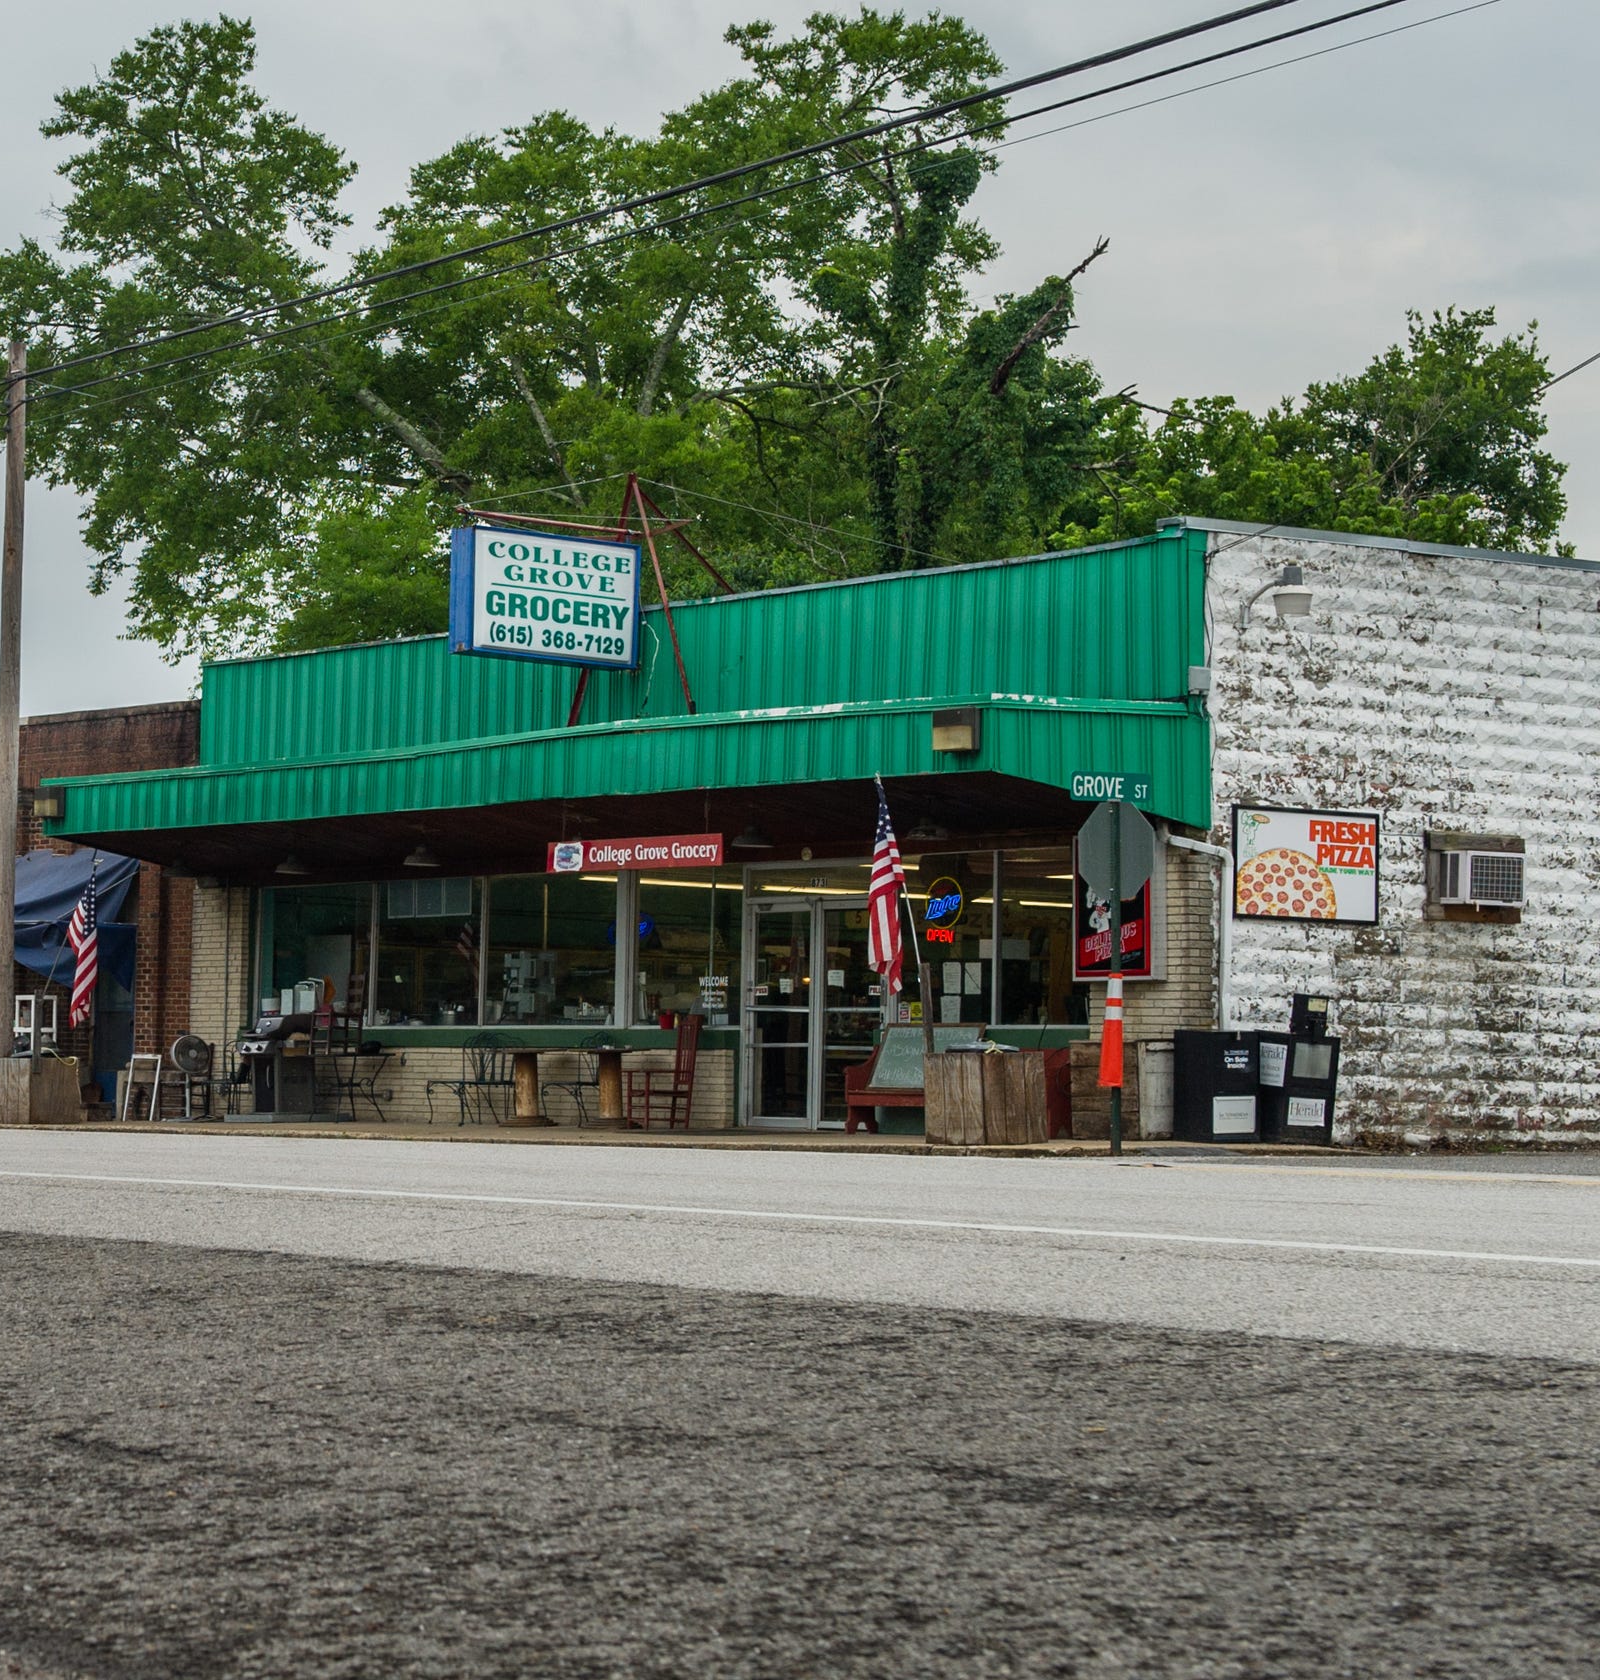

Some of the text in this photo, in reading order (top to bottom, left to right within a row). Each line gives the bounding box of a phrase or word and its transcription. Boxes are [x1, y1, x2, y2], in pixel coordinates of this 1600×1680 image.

[488, 541, 631, 574] COLLEGE
[503, 564, 615, 593] GROVE
[485, 590, 630, 630] GROCERY
[490, 621, 625, 656] (615) 368-7129
[1073, 775, 1148, 799] GROVE ST
[1309, 820, 1376, 846] FRESH
[589, 842, 718, 866] College Grove Grocery
[1316, 844, 1375, 869] PIZZA
[926, 928, 955, 944] OPEN
[1085, 922, 1137, 952] DELICOUS
[1095, 939, 1125, 962] PIZA
[699, 976, 729, 987] WELCOME
[1290, 1102, 1324, 1117] Herald
